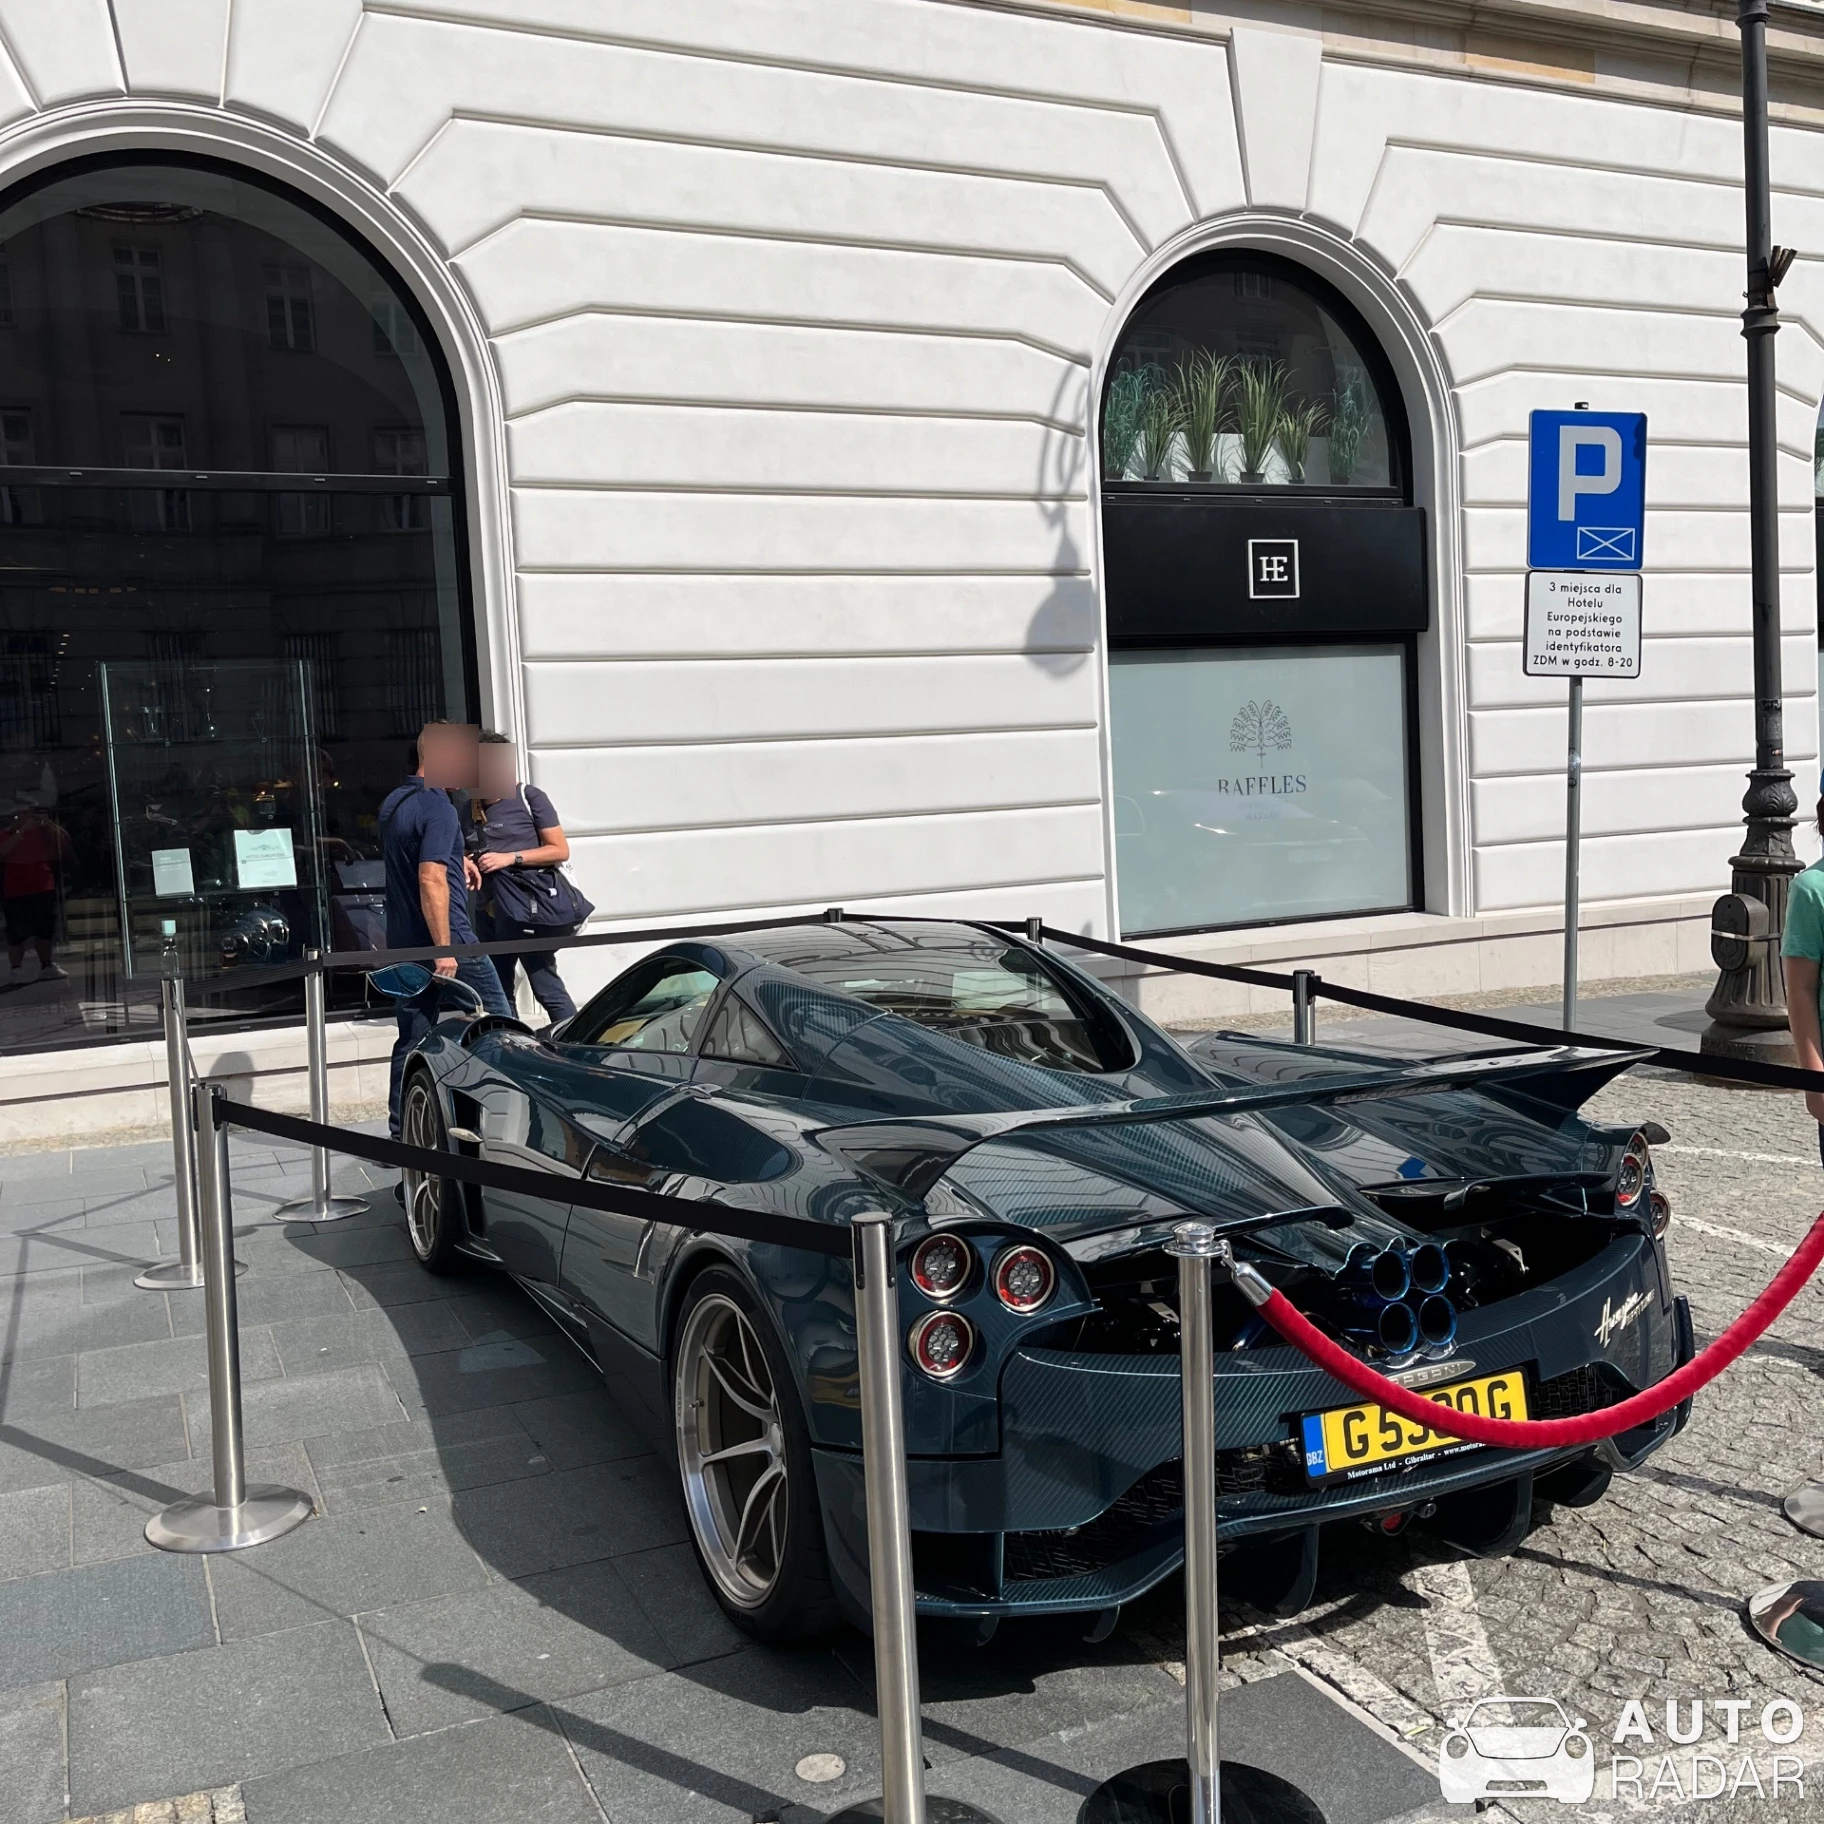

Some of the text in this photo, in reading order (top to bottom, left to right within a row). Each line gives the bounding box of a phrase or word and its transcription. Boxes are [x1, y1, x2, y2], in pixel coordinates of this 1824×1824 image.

[1558, 425, 1622, 521] P
[1259, 556, 1288, 581] HE
[1549, 582, 1622, 595] 3 miejsca dla
[1567, 597, 1603, 608] Hotelu
[1547, 611, 1622, 626] Europejskiego
[1548, 627, 1621, 639] na podstawie
[1545, 641, 1622, 654] identyfikatora
[1533, 654, 1633, 669] ZDM w godz. 8-20
[1217, 775, 1307, 796] RAFFLES
[1306, 1450, 1324, 1466] GBZ
[1347, 1465, 1383, 1480] Motorama
[1384, 1461, 1396, 1471] Ltd
[1404, 1452, 1435, 1466] Gibraltar
